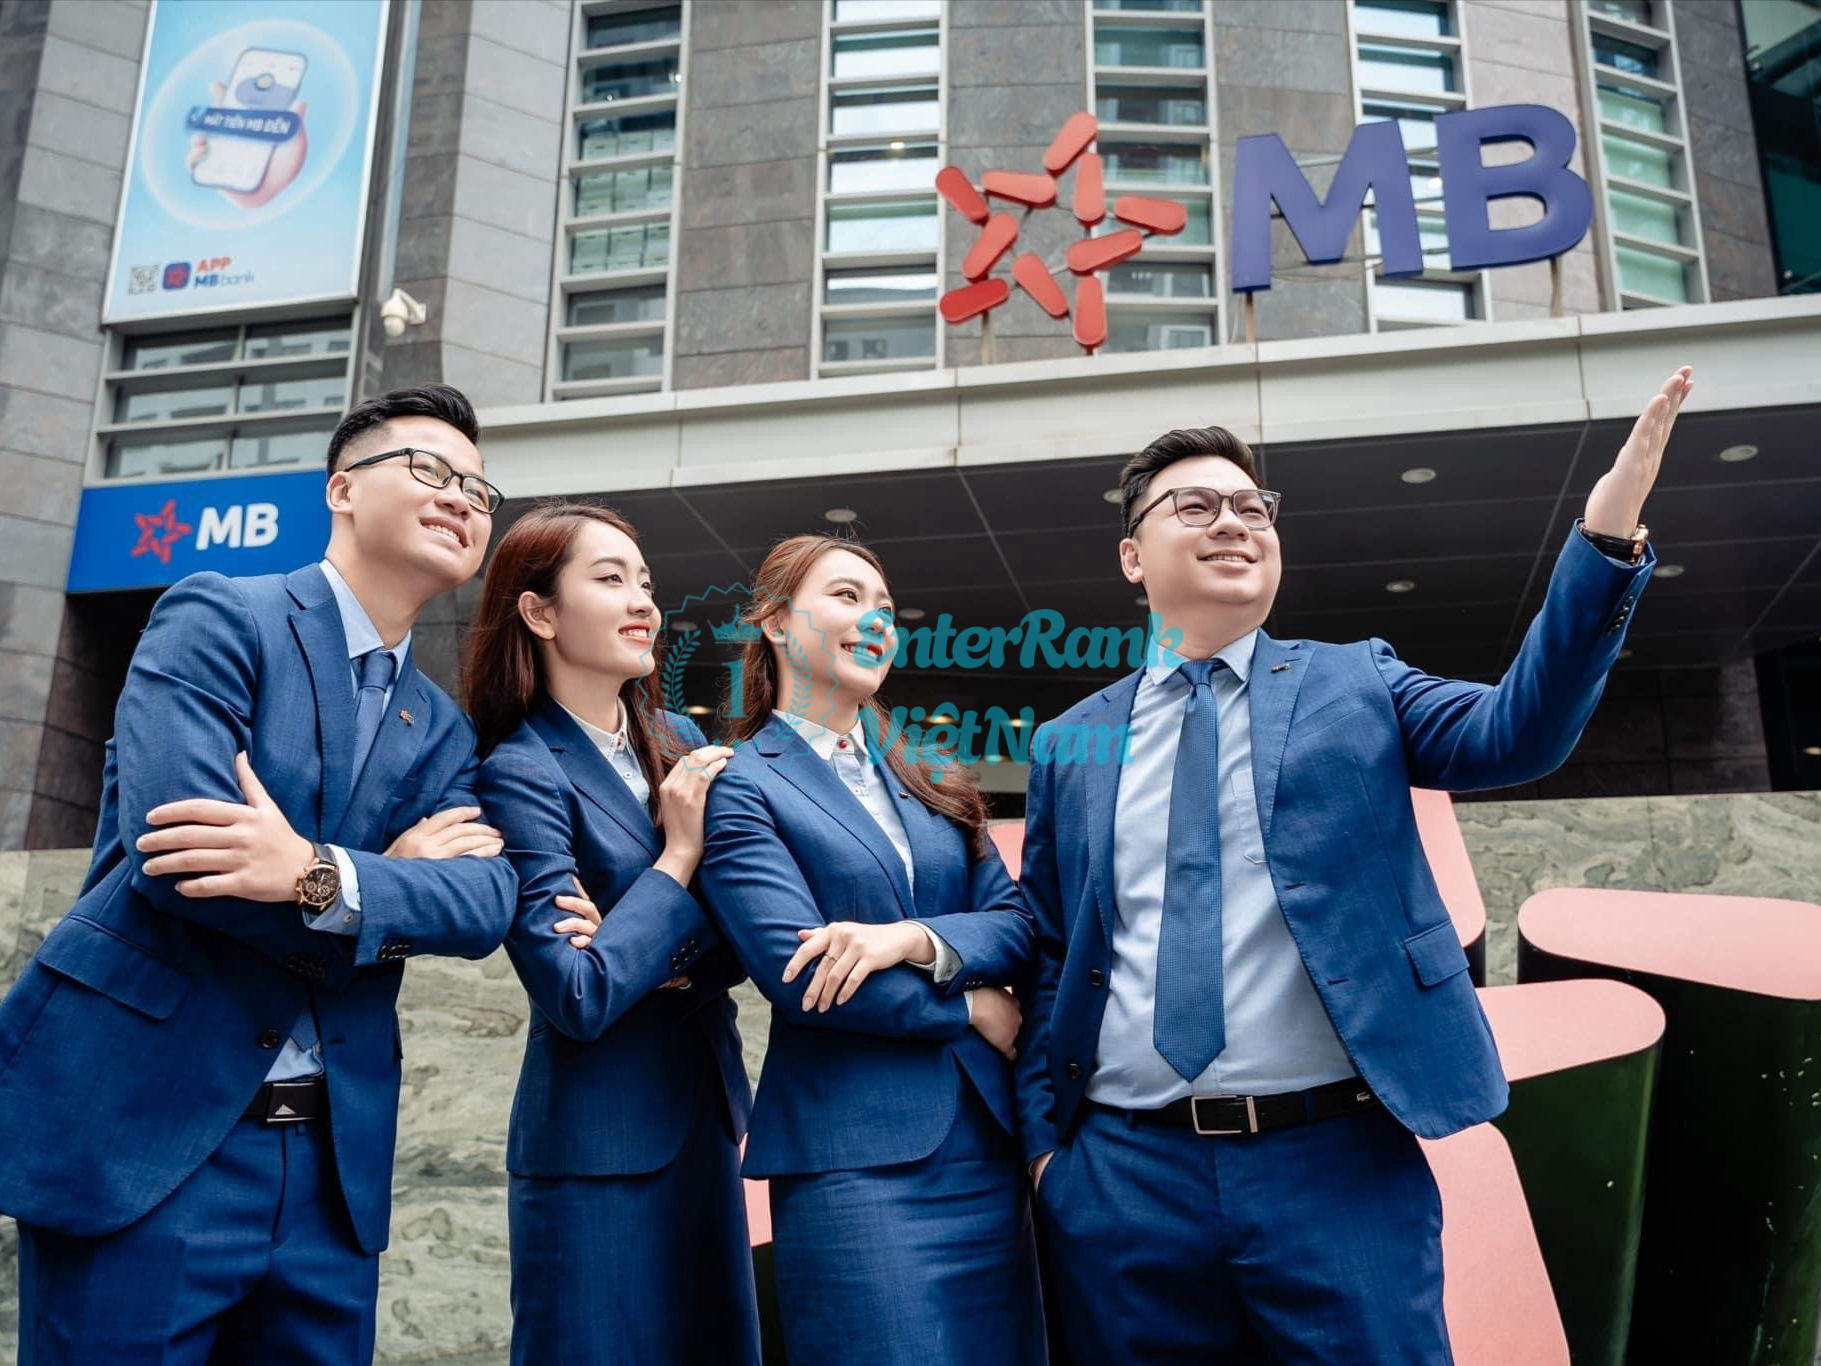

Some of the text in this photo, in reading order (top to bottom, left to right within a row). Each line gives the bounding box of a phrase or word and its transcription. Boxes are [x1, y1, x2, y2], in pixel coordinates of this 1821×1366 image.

[1232, 104, 1594, 293] MB
[197, 256, 232, 272] APP
[195, 502, 279, 551] MB
